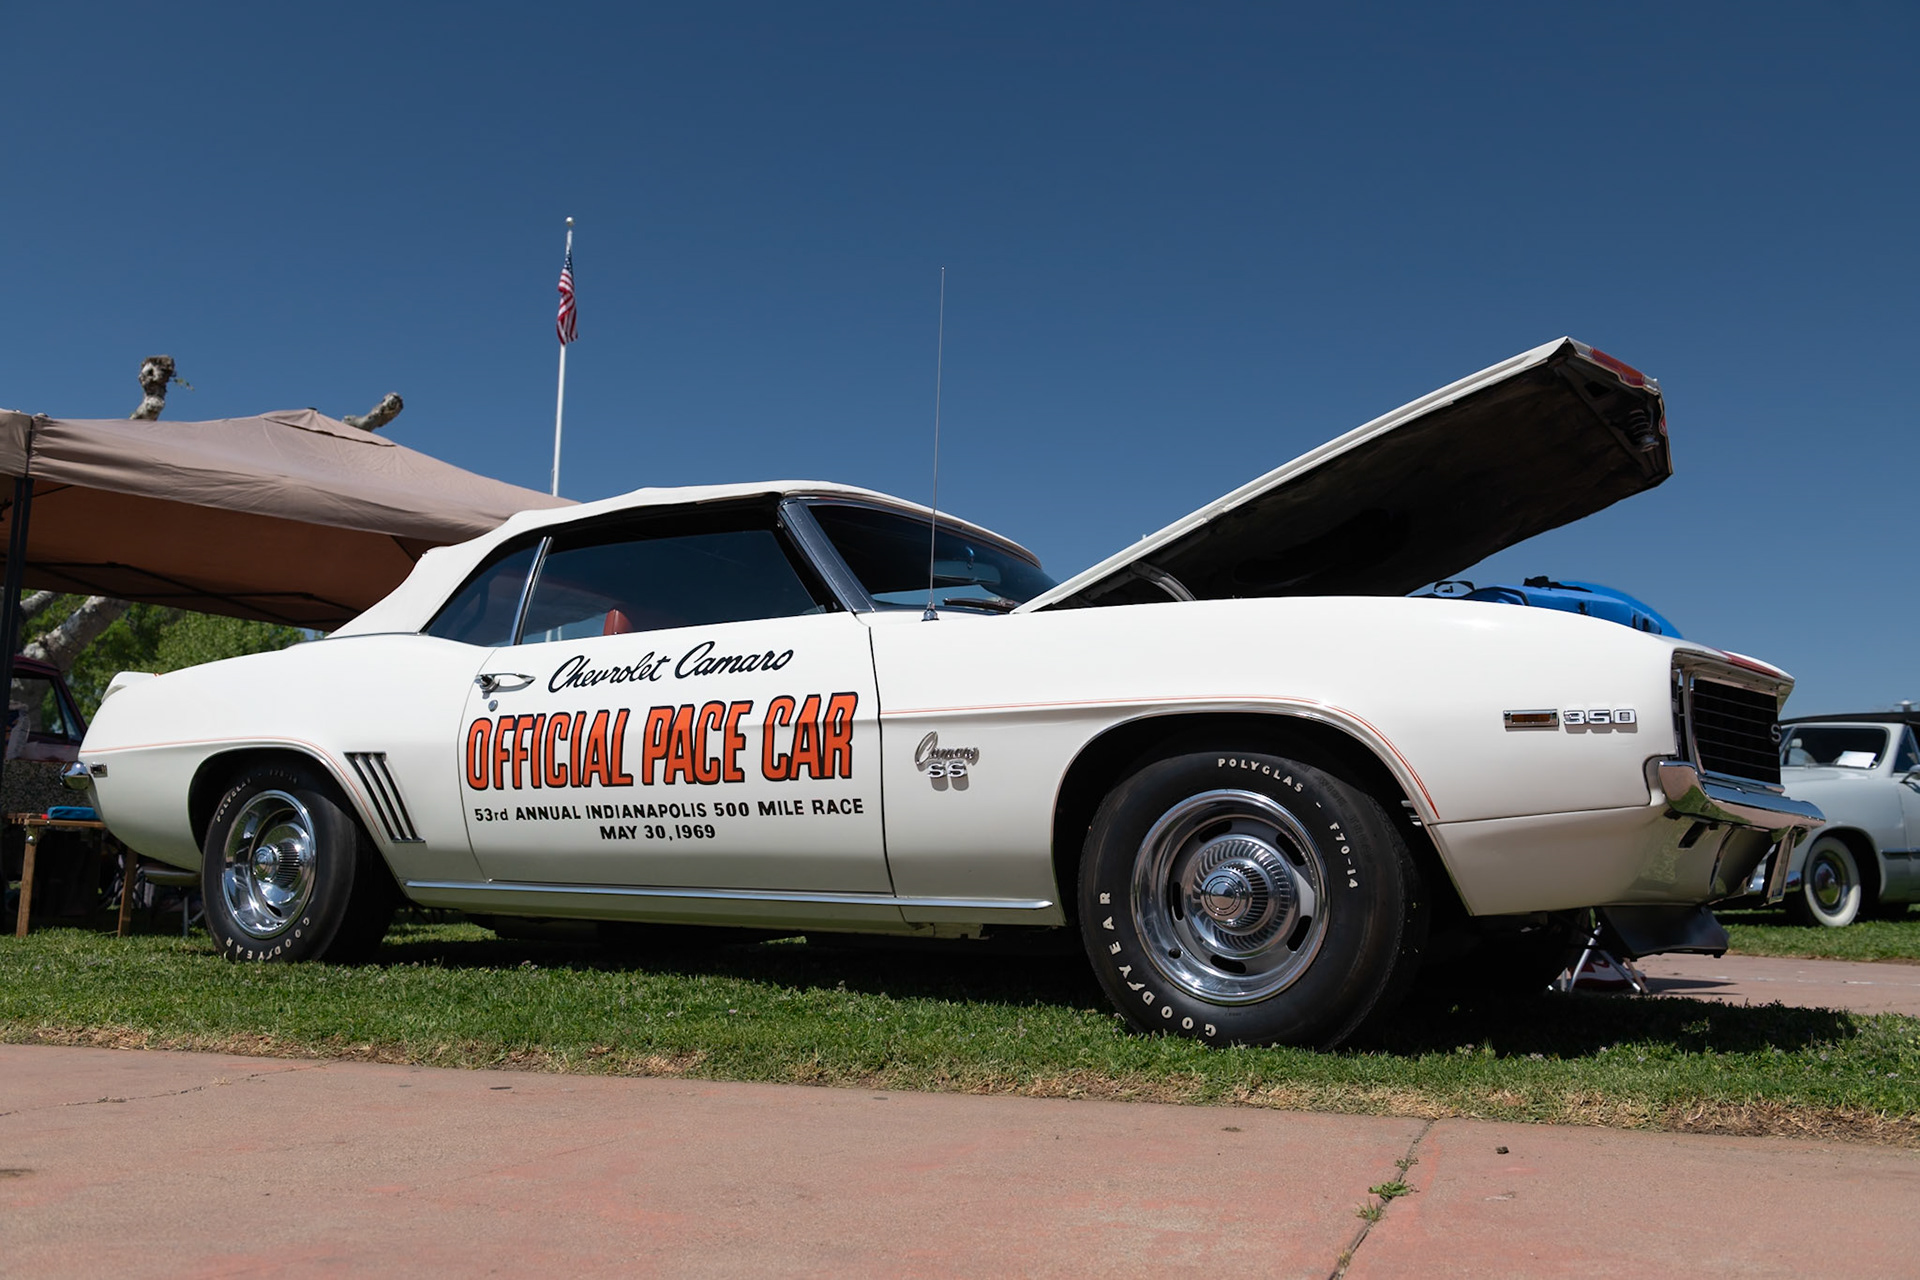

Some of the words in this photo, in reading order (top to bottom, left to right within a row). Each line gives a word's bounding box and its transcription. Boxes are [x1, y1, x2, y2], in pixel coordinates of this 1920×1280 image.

[548, 651, 671, 693] Chevrolet
[674, 641, 794, 680] Camaro
[1563, 709, 1636, 725] 350
[466, 708, 634, 790] OFFICIAL
[641, 700, 754, 786] PACE
[761, 692, 859, 781] CAR
[928, 762, 966, 778] SS
[475, 808, 508, 822] 53rd
[515, 805, 581, 821] ANNUAL
[586, 802, 707, 820] INDIANAPOLIS
[714, 802, 749, 818] 500
[758, 799, 804, 817] MILE
[812, 798, 864, 815] RACE
[1217, 758, 1303, 793] POLYGLAS
[1329, 822, 1358, 889] F70-14
[600, 825, 637, 840] MAY
[226, 917, 310, 961] GOODYEAR
[1100, 891, 1217, 1037] GOODYEAR
